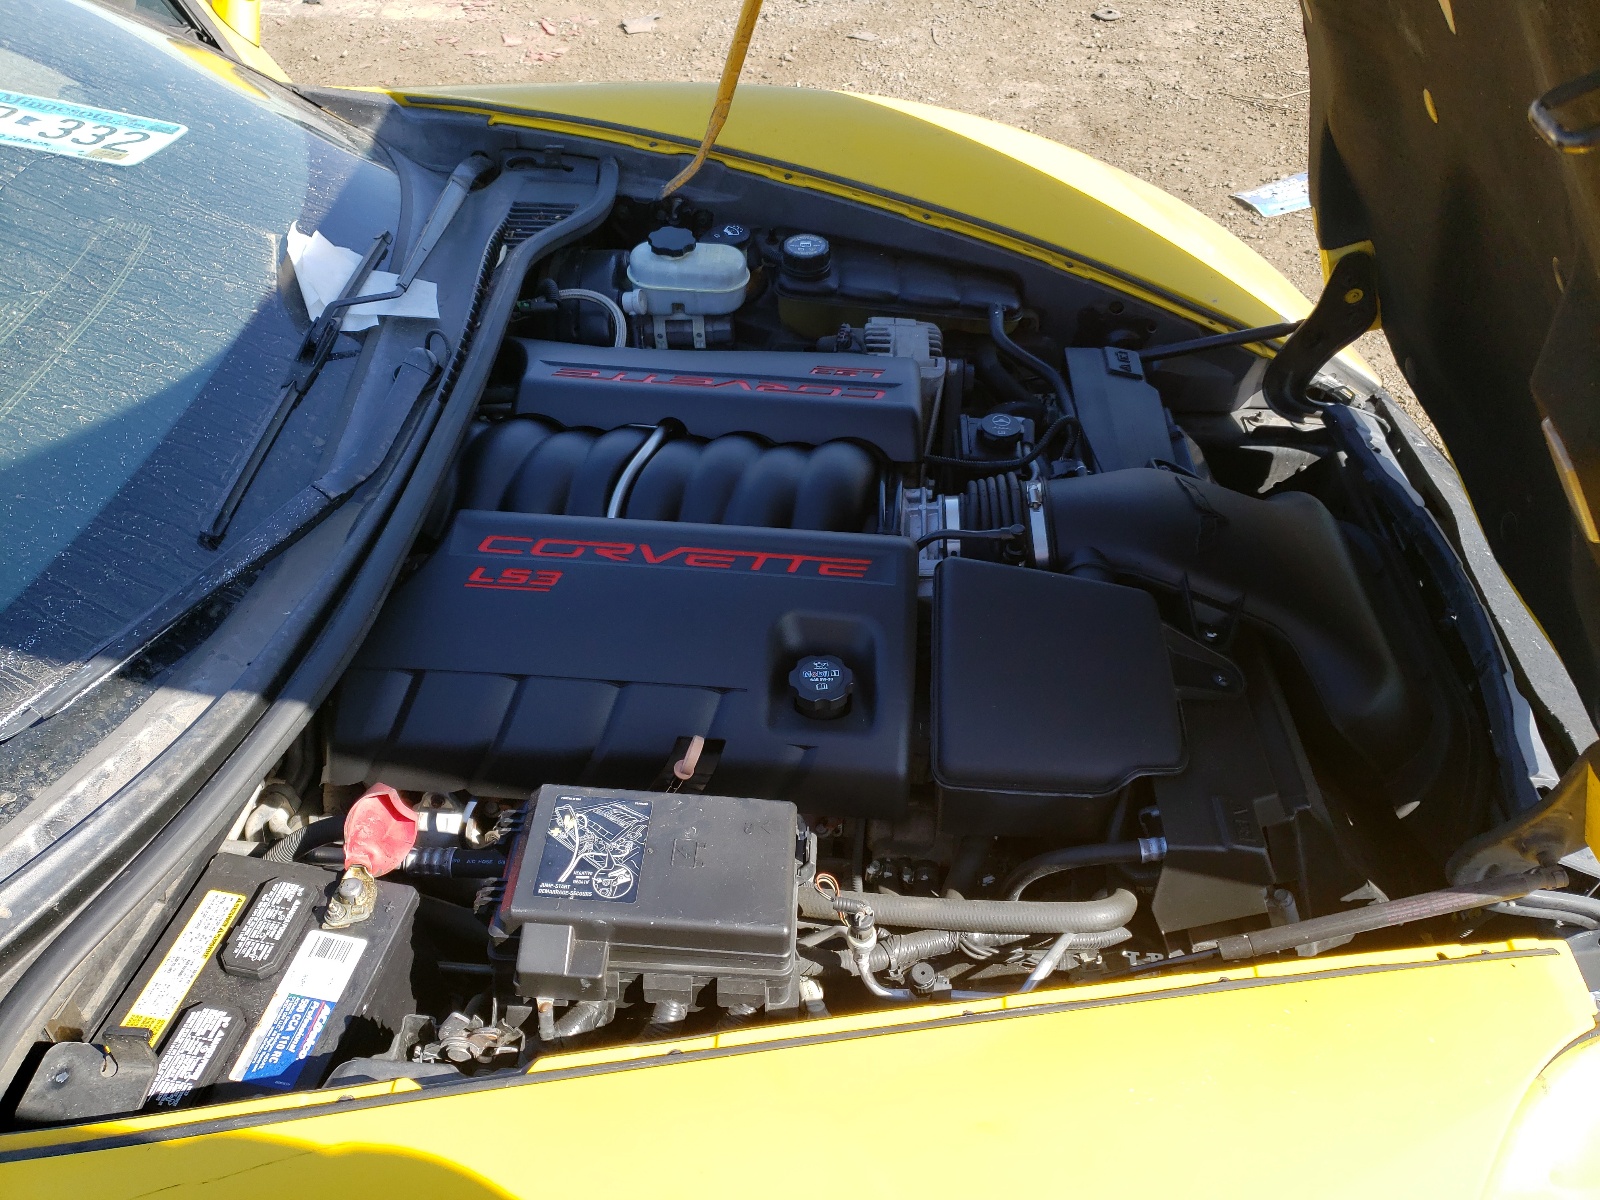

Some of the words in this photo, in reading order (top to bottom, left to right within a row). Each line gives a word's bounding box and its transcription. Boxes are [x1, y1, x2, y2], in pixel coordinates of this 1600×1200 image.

[38, 118, 151, 153] 332
[550, 367, 887, 400] CORVETTE
[477, 534, 873, 578] CORVETTE
[464, 566, 564, 592] LS3
[285, 1013, 301, 1032] CCA
[288, 1000, 321, 1053] Professional
[299, 1004, 331, 1060] ACDelco
[269, 1050, 283, 1064] RC
